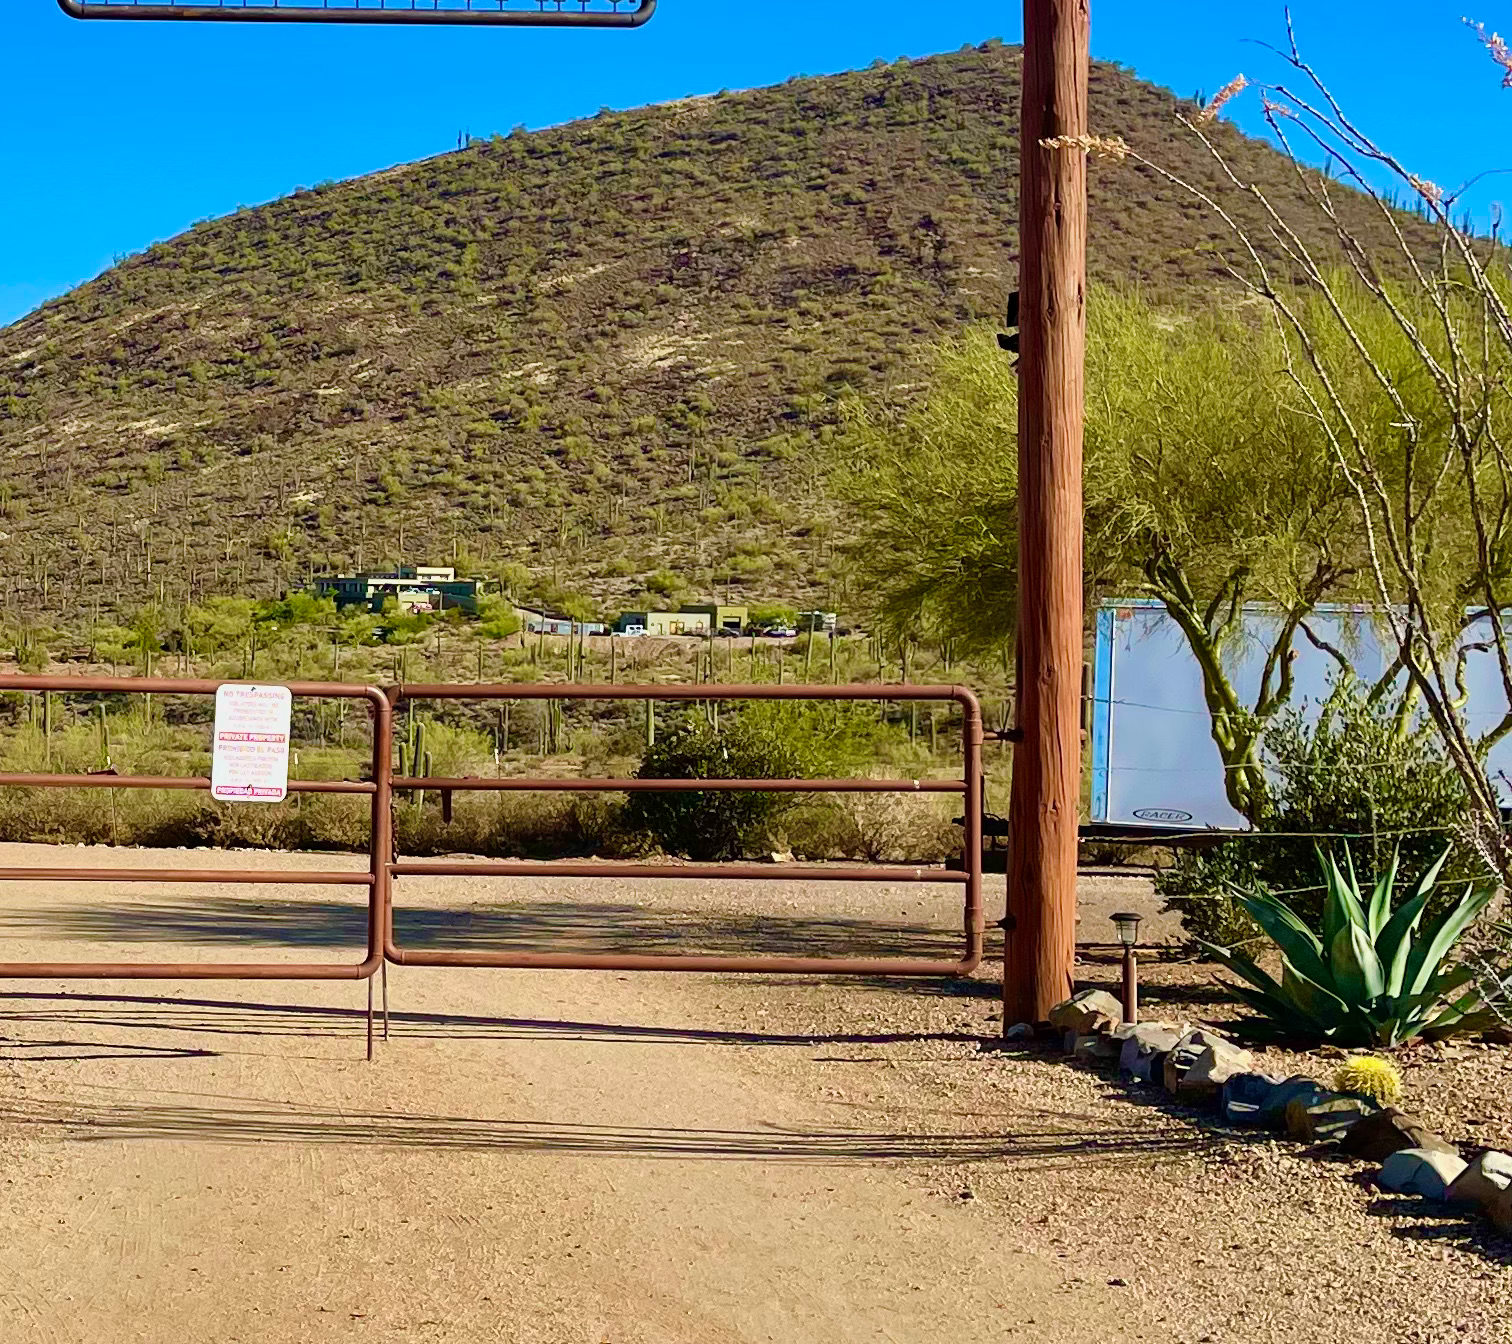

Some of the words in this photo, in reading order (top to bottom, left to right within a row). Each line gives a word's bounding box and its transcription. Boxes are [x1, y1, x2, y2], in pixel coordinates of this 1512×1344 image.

[223, 690, 234, 698] NO
[236, 690, 285, 700] TRESPASSING
[219, 733, 249, 741] PRIVATE
[249, 734, 285, 742] PROPERTY
[267, 746, 285, 754] PASO
[1140, 811, 1185, 820] RACER
